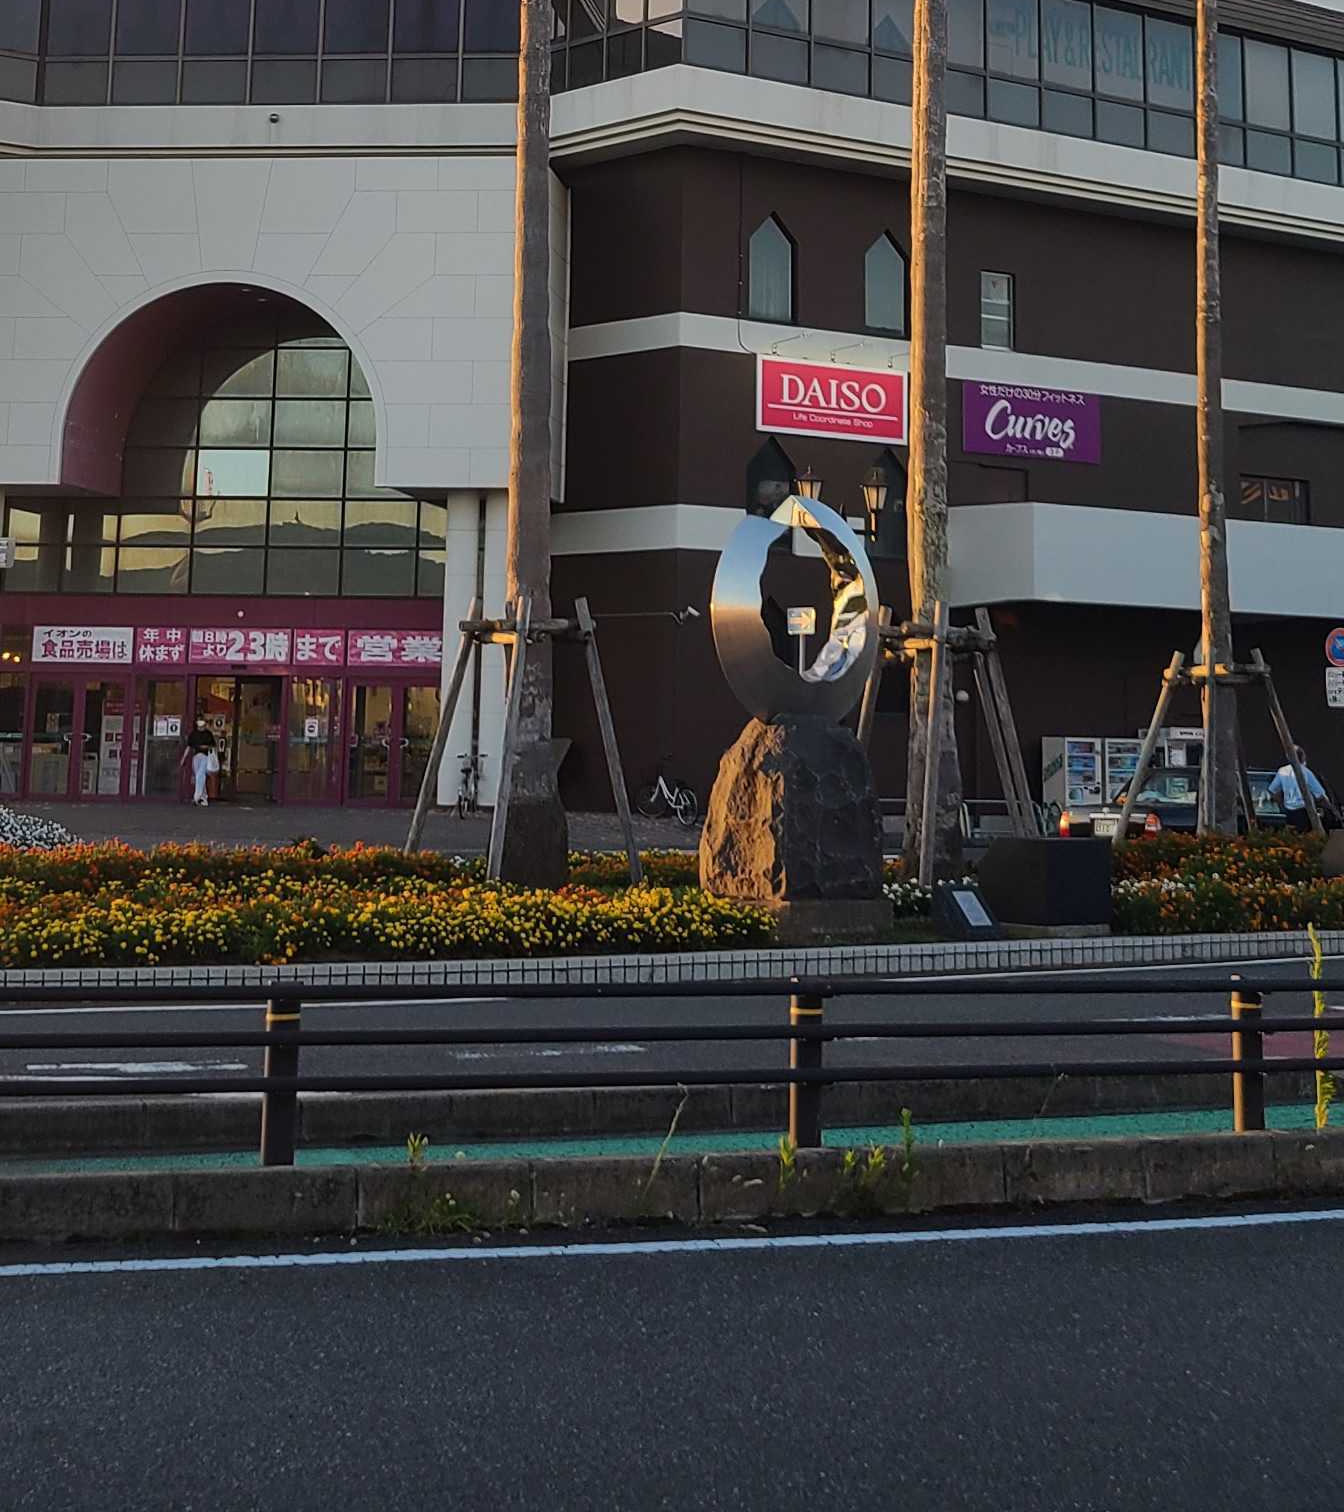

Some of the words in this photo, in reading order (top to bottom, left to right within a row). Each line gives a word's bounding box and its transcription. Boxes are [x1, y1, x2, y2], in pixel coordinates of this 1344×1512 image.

[780, 373, 887, 414] DAISO
[984, 399, 1076, 449] Curves
[42, 628, 93, 638] イオンの
[41, 639, 128, 659] 食品売場は
[138, 644, 185, 662] 休まず
[203, 644, 227, 657] より
[225, 630, 289, 662] 23時
[296, 633, 342, 661] まで
